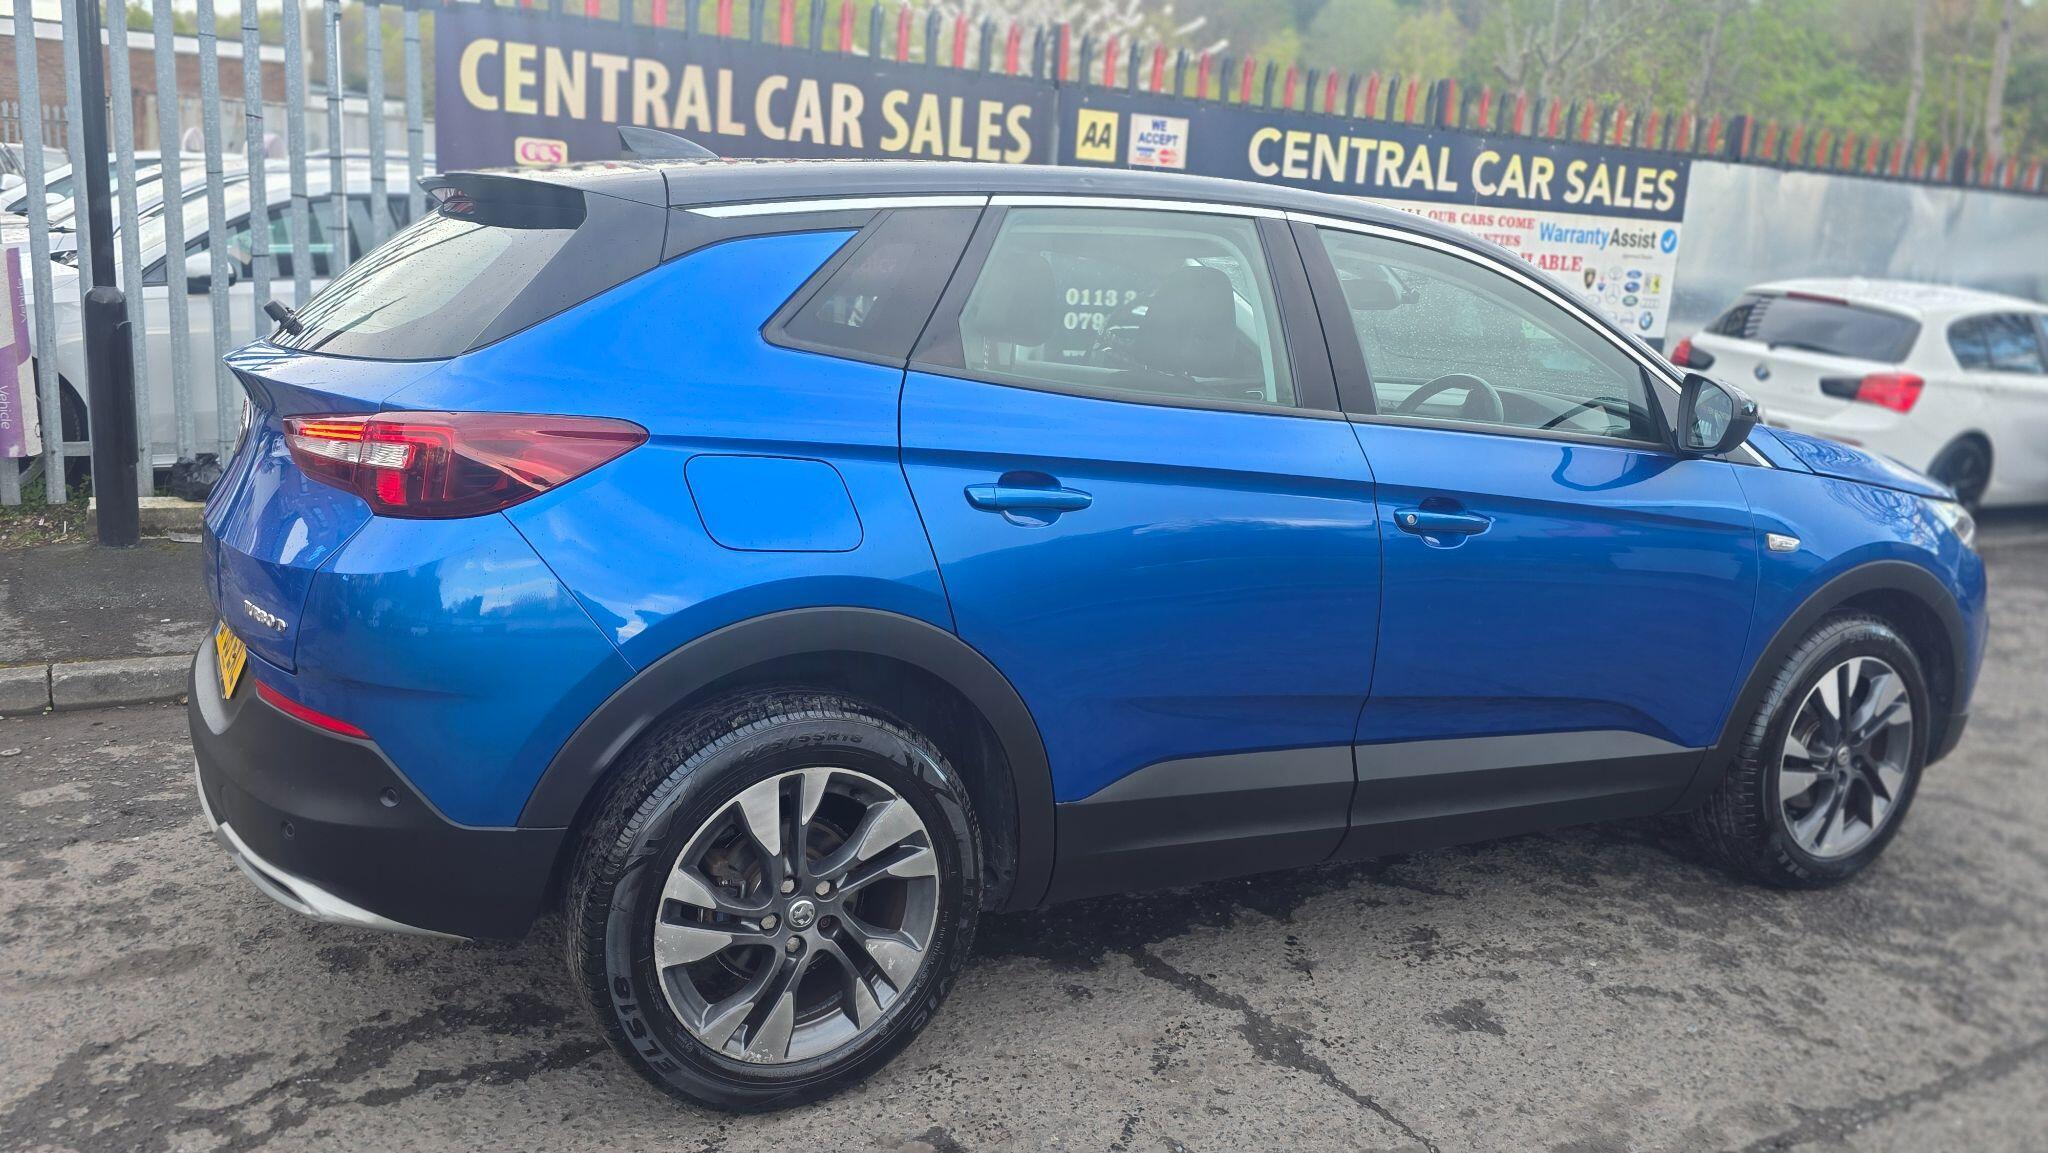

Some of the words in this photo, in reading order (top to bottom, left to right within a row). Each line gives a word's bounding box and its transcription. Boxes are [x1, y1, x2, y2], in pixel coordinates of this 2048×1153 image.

[459, 38, 746, 136] CENTRAL
[755, 75, 863, 148] CAR
[880, 89, 1032, 164] SALES
[1082, 121, 1112, 149] AA
[1152, 120, 1173, 132] WE
[1138, 132, 1179, 147] ACCEPT
[521, 142, 562, 163] CCS
[1249, 127, 1458, 192] CENTRAL
[1472, 151, 1554, 200] CAR
[1563, 160, 1678, 211] SALES
[1428, 210, 1456, 224] OUR
[1461, 212, 1494, 226] CARS
[1498, 215, 1535, 229] COME
[1521, 253, 1583, 271] ABLE
[1066, 288, 1118, 307] 0113
[0, 385, 13, 430] Vehicle
